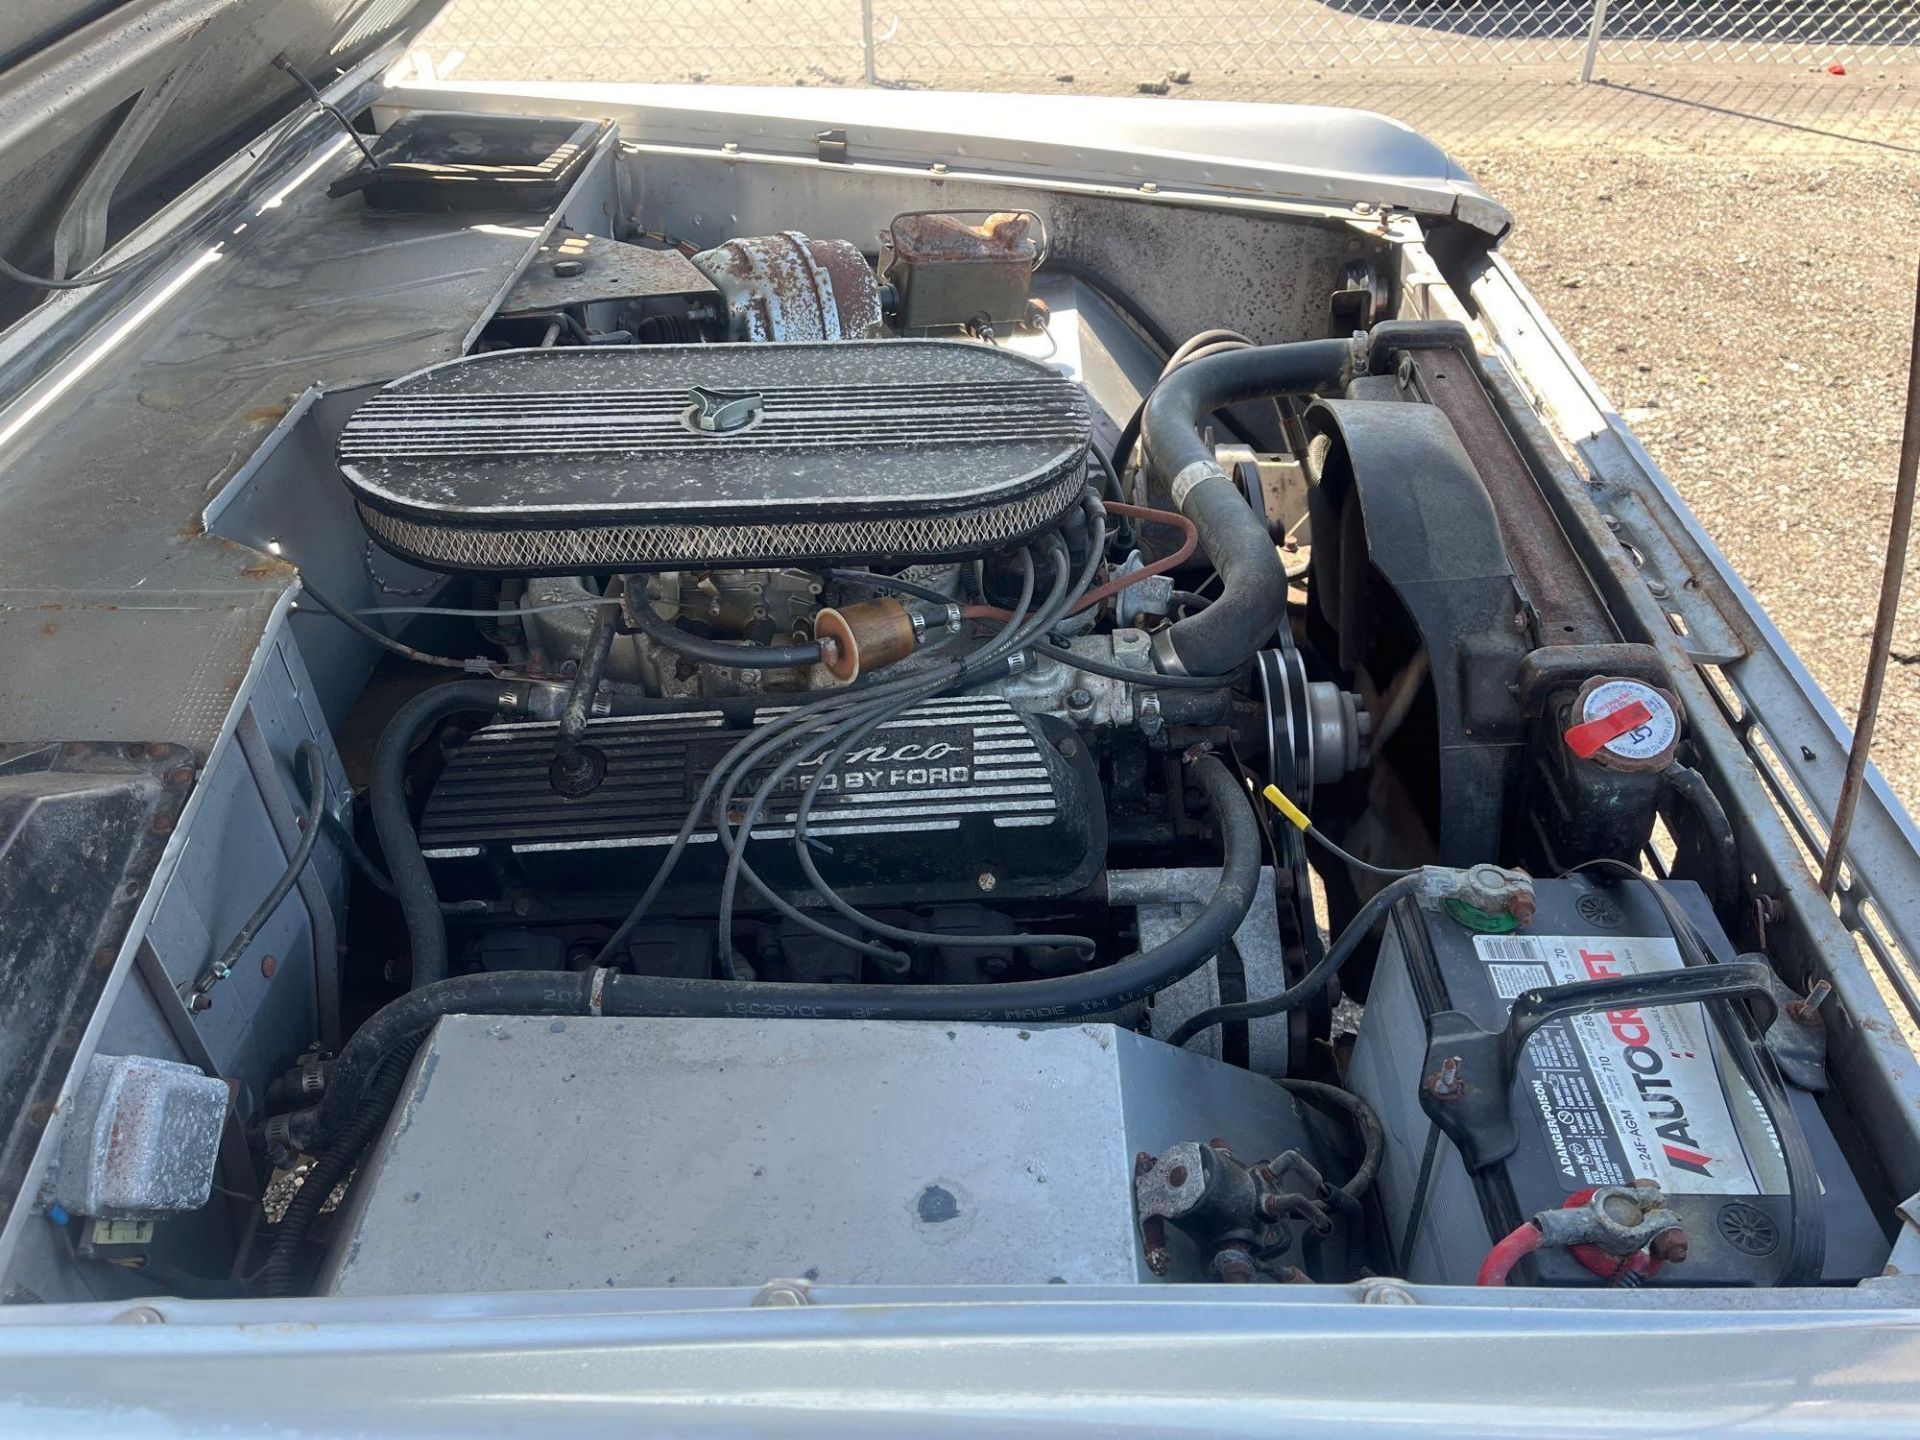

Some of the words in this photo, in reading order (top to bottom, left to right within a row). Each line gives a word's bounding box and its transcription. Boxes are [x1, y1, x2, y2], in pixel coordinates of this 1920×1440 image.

[1629, 725, 1652, 745] CST
[844, 771, 884, 789] BY
[890, 766, 969, 785] FORD
[1553, 948, 1566, 957] 70
[1580, 1015, 1595, 1026] 88
[1574, 949, 1703, 1149] AUTOCRFT
[1597, 1056, 1615, 1072] 710
[1530, 1080, 1572, 1164] DANGER/POISON
[1619, 1109, 1652, 1160] 24F-AGM
